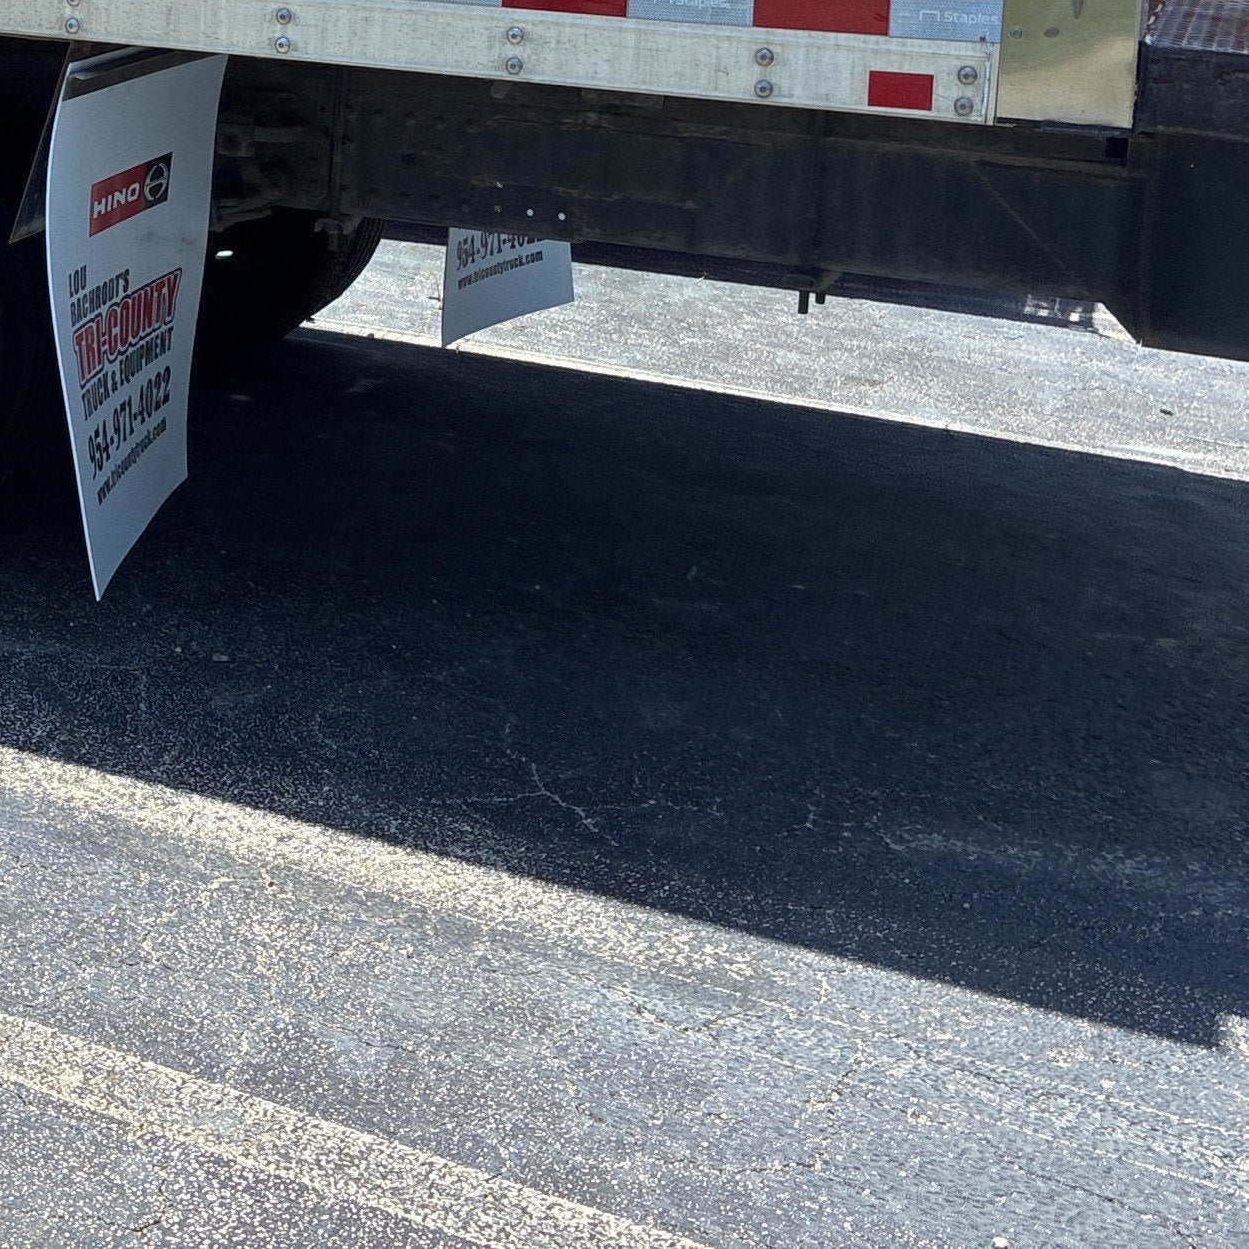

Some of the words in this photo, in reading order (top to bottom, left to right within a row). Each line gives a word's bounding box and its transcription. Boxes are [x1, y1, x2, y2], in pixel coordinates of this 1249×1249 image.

[943, 10, 1000, 26] Staples
[93, 182, 140, 219] HINO
[68, 264, 87, 299] LOU
[73, 267, 183, 390] TRI-COUNTY
[81, 371, 111, 421] TRUCK
[111, 370, 118, 394] &
[119, 325, 174, 387] EQUIPMENT
[88, 365, 171, 480] 954-971-4022
